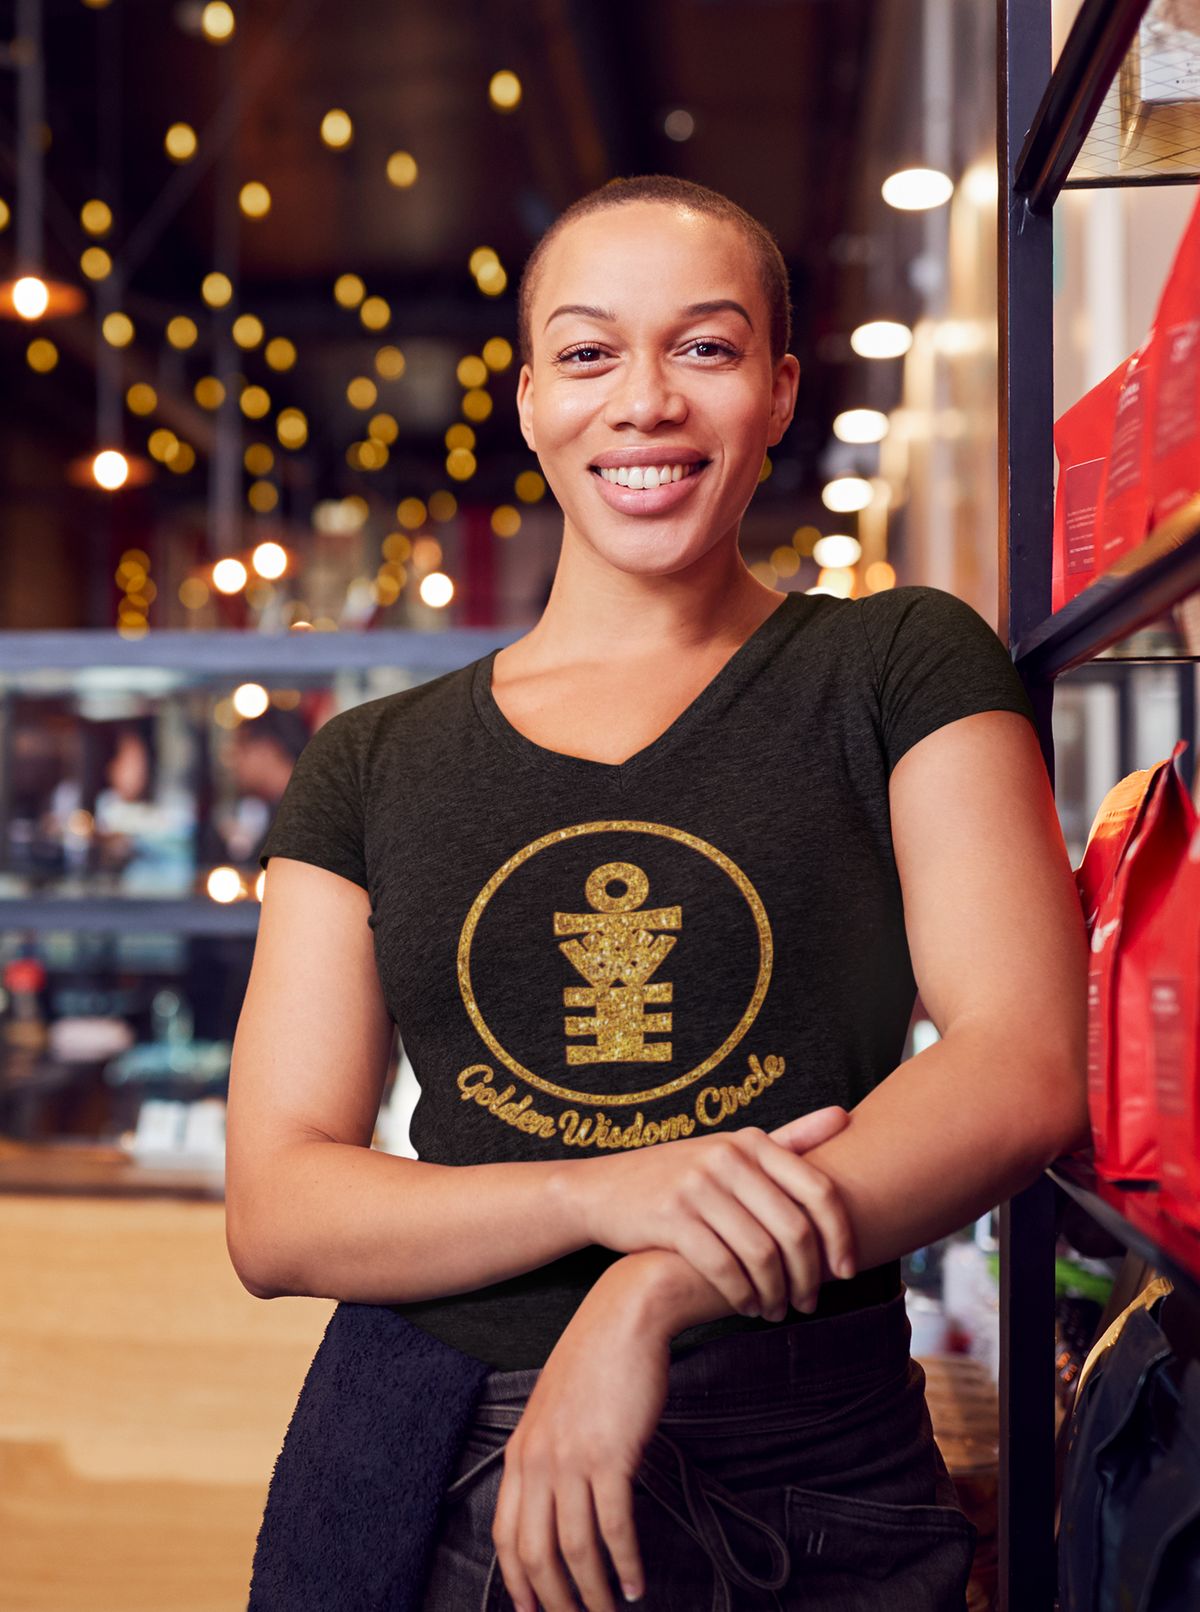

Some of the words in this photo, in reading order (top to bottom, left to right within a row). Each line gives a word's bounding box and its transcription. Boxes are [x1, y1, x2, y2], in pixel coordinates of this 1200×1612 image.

[457, 1064, 556, 1138] Golden
[558, 1110, 695, 1148] Wisdom
[695, 1054, 785, 1126] Circle
